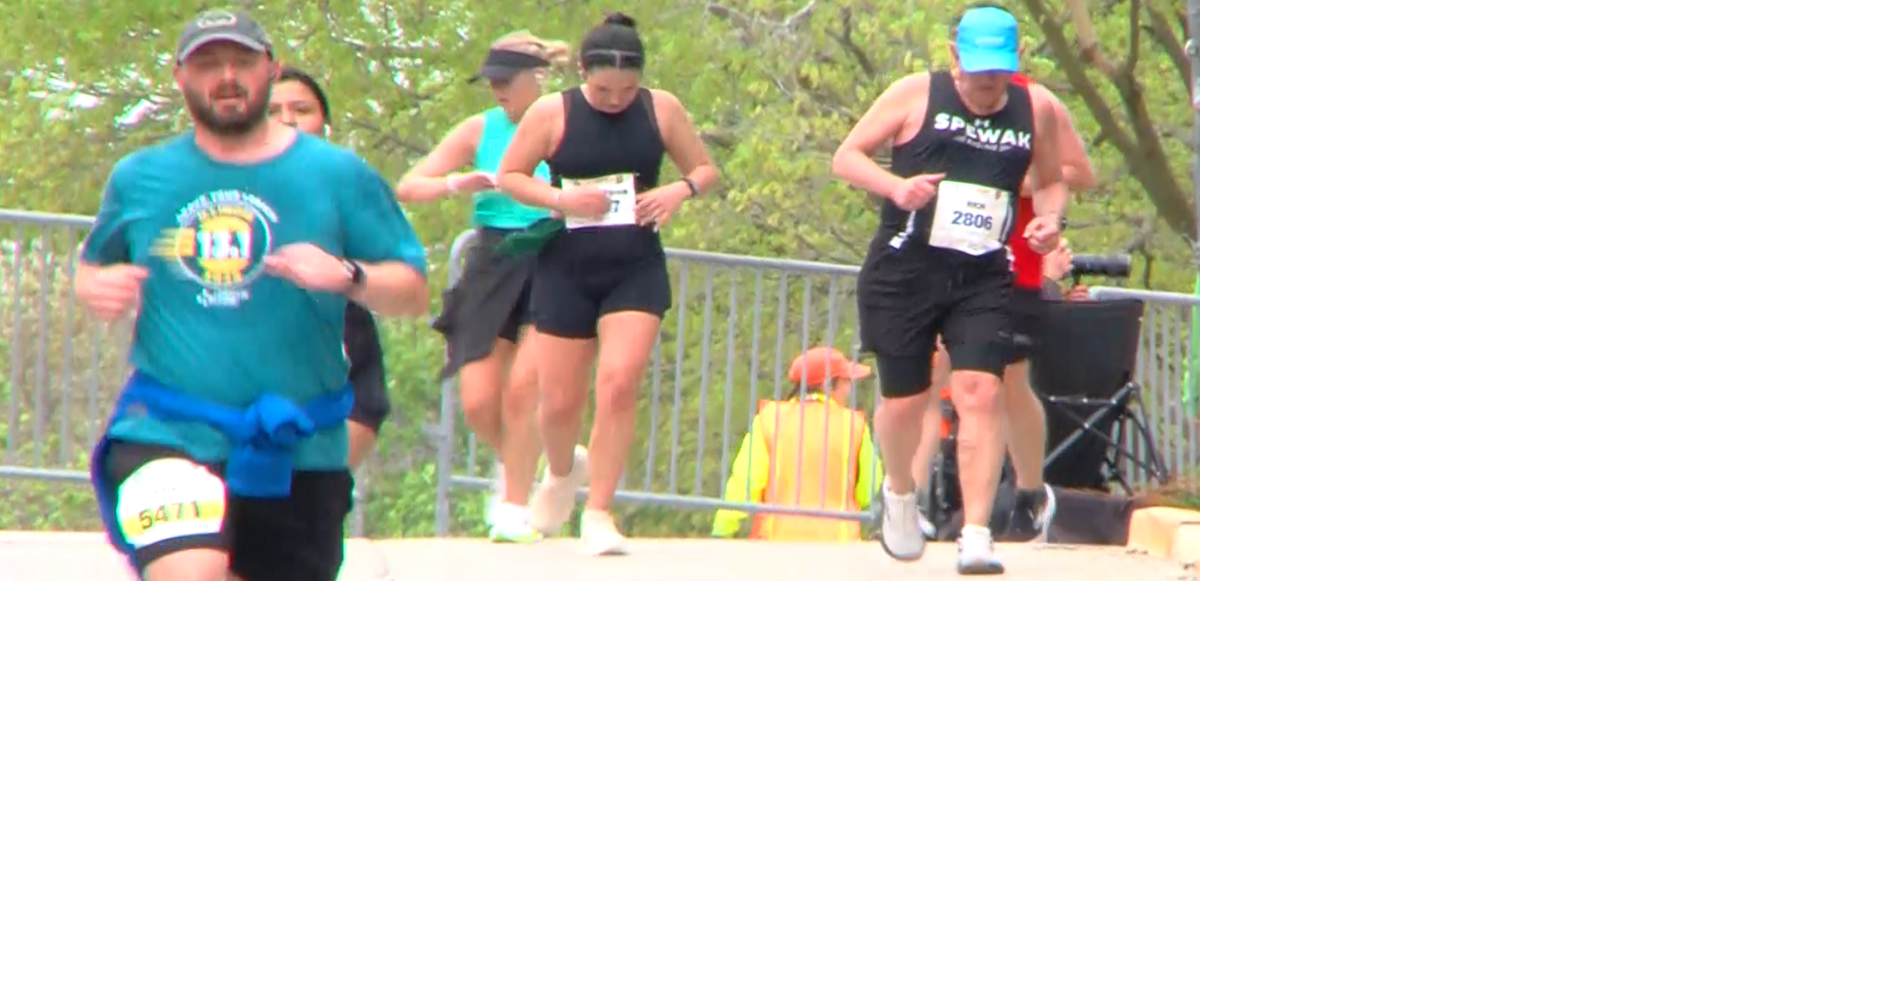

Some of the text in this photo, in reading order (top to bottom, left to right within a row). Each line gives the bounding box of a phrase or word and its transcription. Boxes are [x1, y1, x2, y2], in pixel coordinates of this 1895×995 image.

[934, 112, 1031, 150] SPEWAK
[951, 210, 993, 231] 2806
[197, 229, 251, 259] 13.1
[139, 500, 200, 530] 5471
